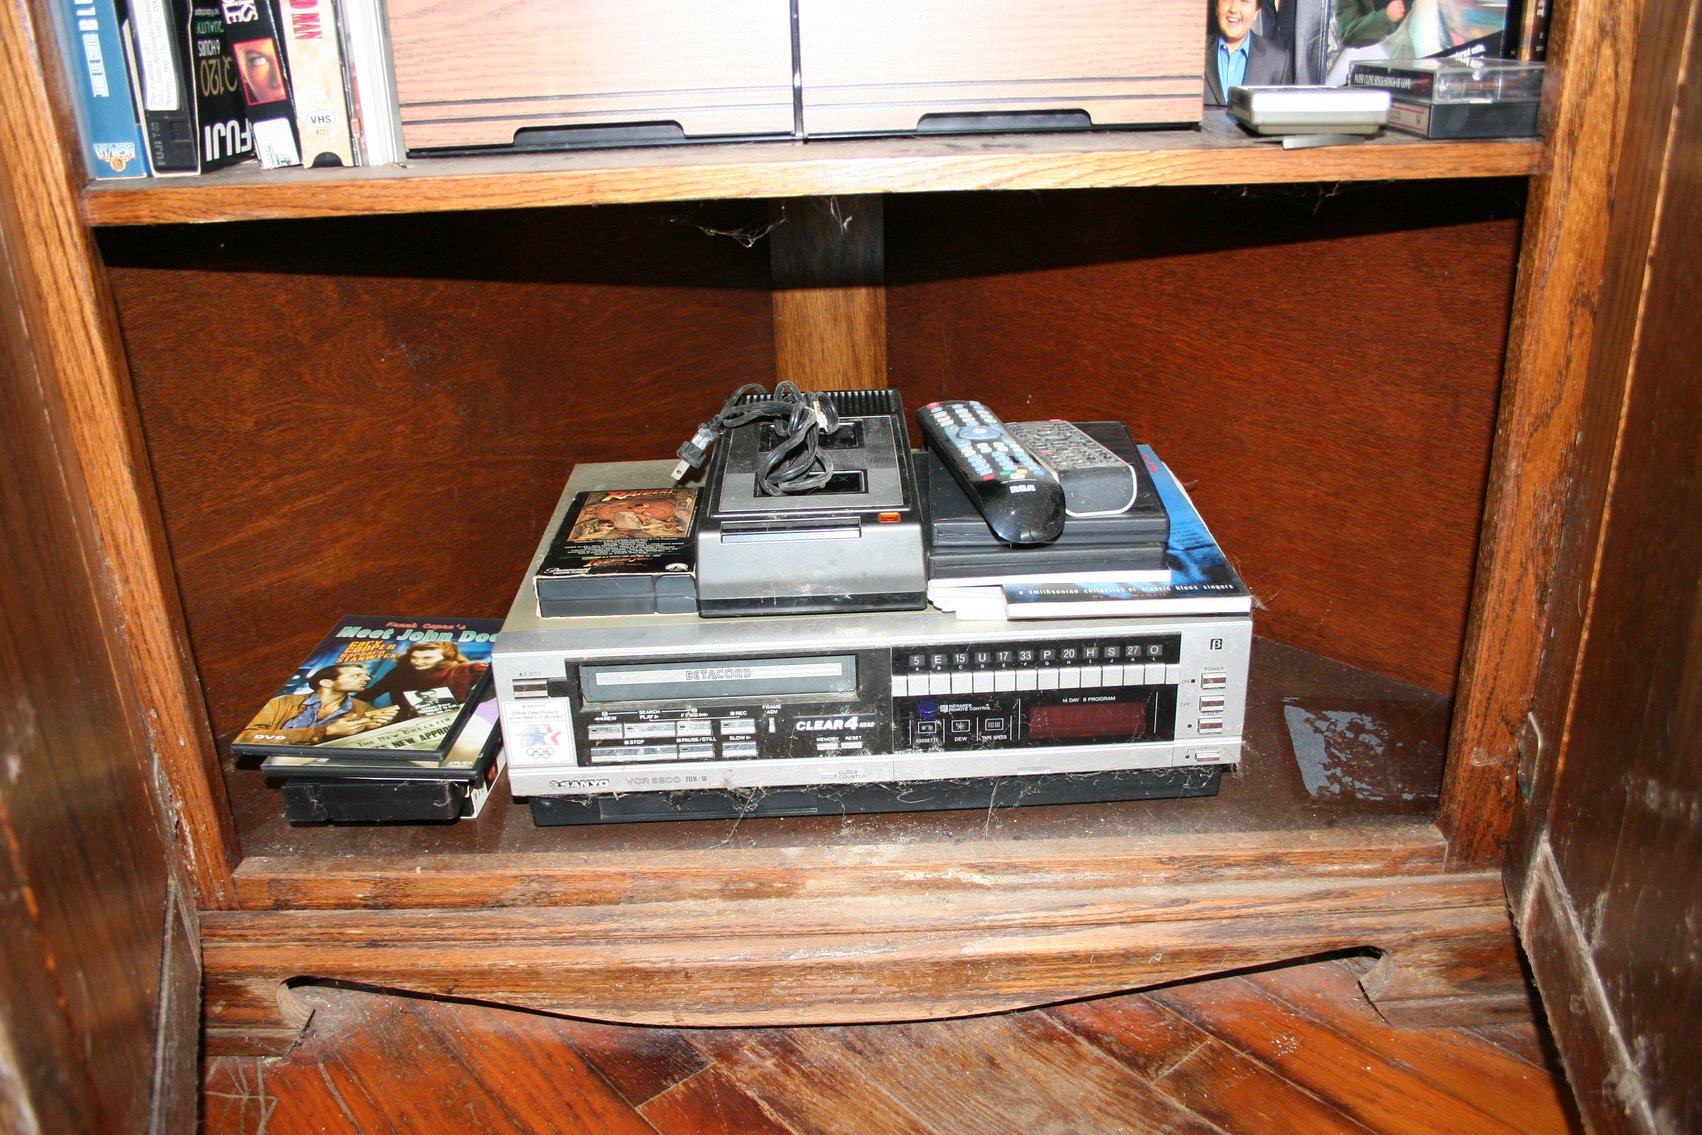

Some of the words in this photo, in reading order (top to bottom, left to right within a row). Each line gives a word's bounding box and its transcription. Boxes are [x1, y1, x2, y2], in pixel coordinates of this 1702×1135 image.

[196, 20, 225, 34] QUALITY
[292, 12, 323, 40] MAN
[310, 115, 332, 124] VHS
[204, 118, 253, 162] FUJI
[154, 141, 166, 166] FUJI
[1009, 484, 1036, 494] RCA
[335, 626, 395, 639] Meet
[396, 628, 454, 642] John
[913, 656, 920, 665] 5
[934, 655, 942, 664] E
[955, 654, 966, 663] 15
[978, 653, 987, 662] U
[998, 652, 1008, 661] 17
[1019, 651, 1032, 660] 33
[1043, 650, 1051, 659] P
[1063, 649, 1075, 658] 20
[1086, 648, 1095, 657] H
[1107, 648, 1116, 657] S
[1127, 646, 1139, 655] 27
[685, 668, 752, 681] BETACORD
[796, 719, 844, 731] CLEAR
[844, 716, 859, 731] 4
[391, 737, 415, 749] NEW
[559, 778, 610, 789] SANYO
[625, 777, 650, 785] VCR
